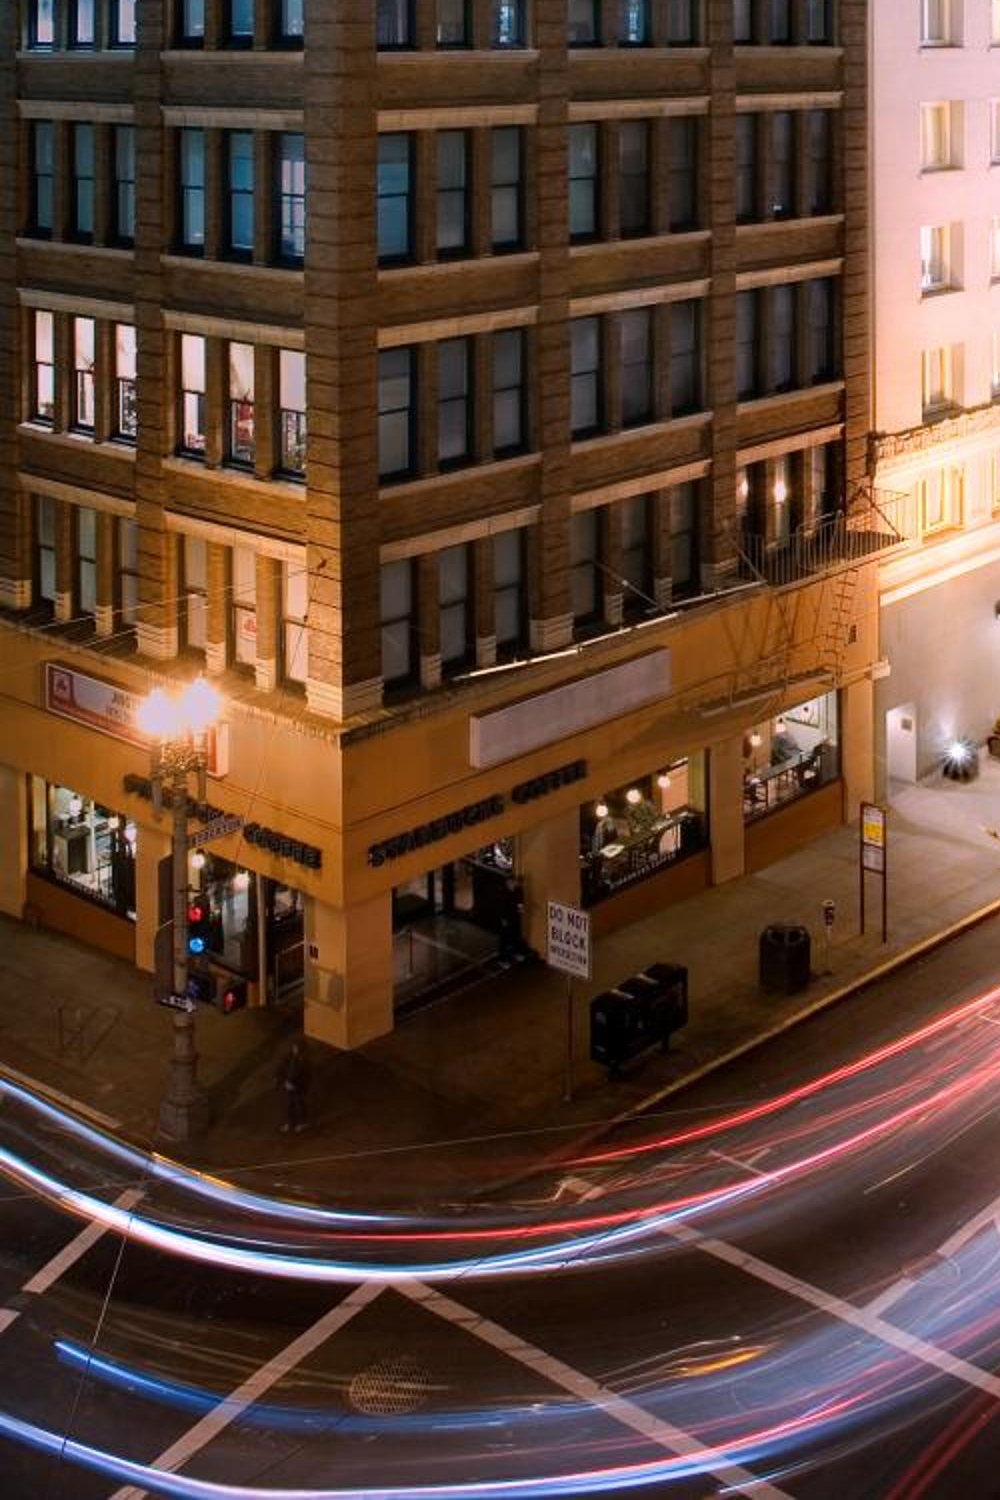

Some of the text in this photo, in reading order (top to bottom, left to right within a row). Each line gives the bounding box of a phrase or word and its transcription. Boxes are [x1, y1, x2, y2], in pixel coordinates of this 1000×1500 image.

[549, 905, 588, 932] DO NOT
[551, 926, 586, 949] BLOCK
